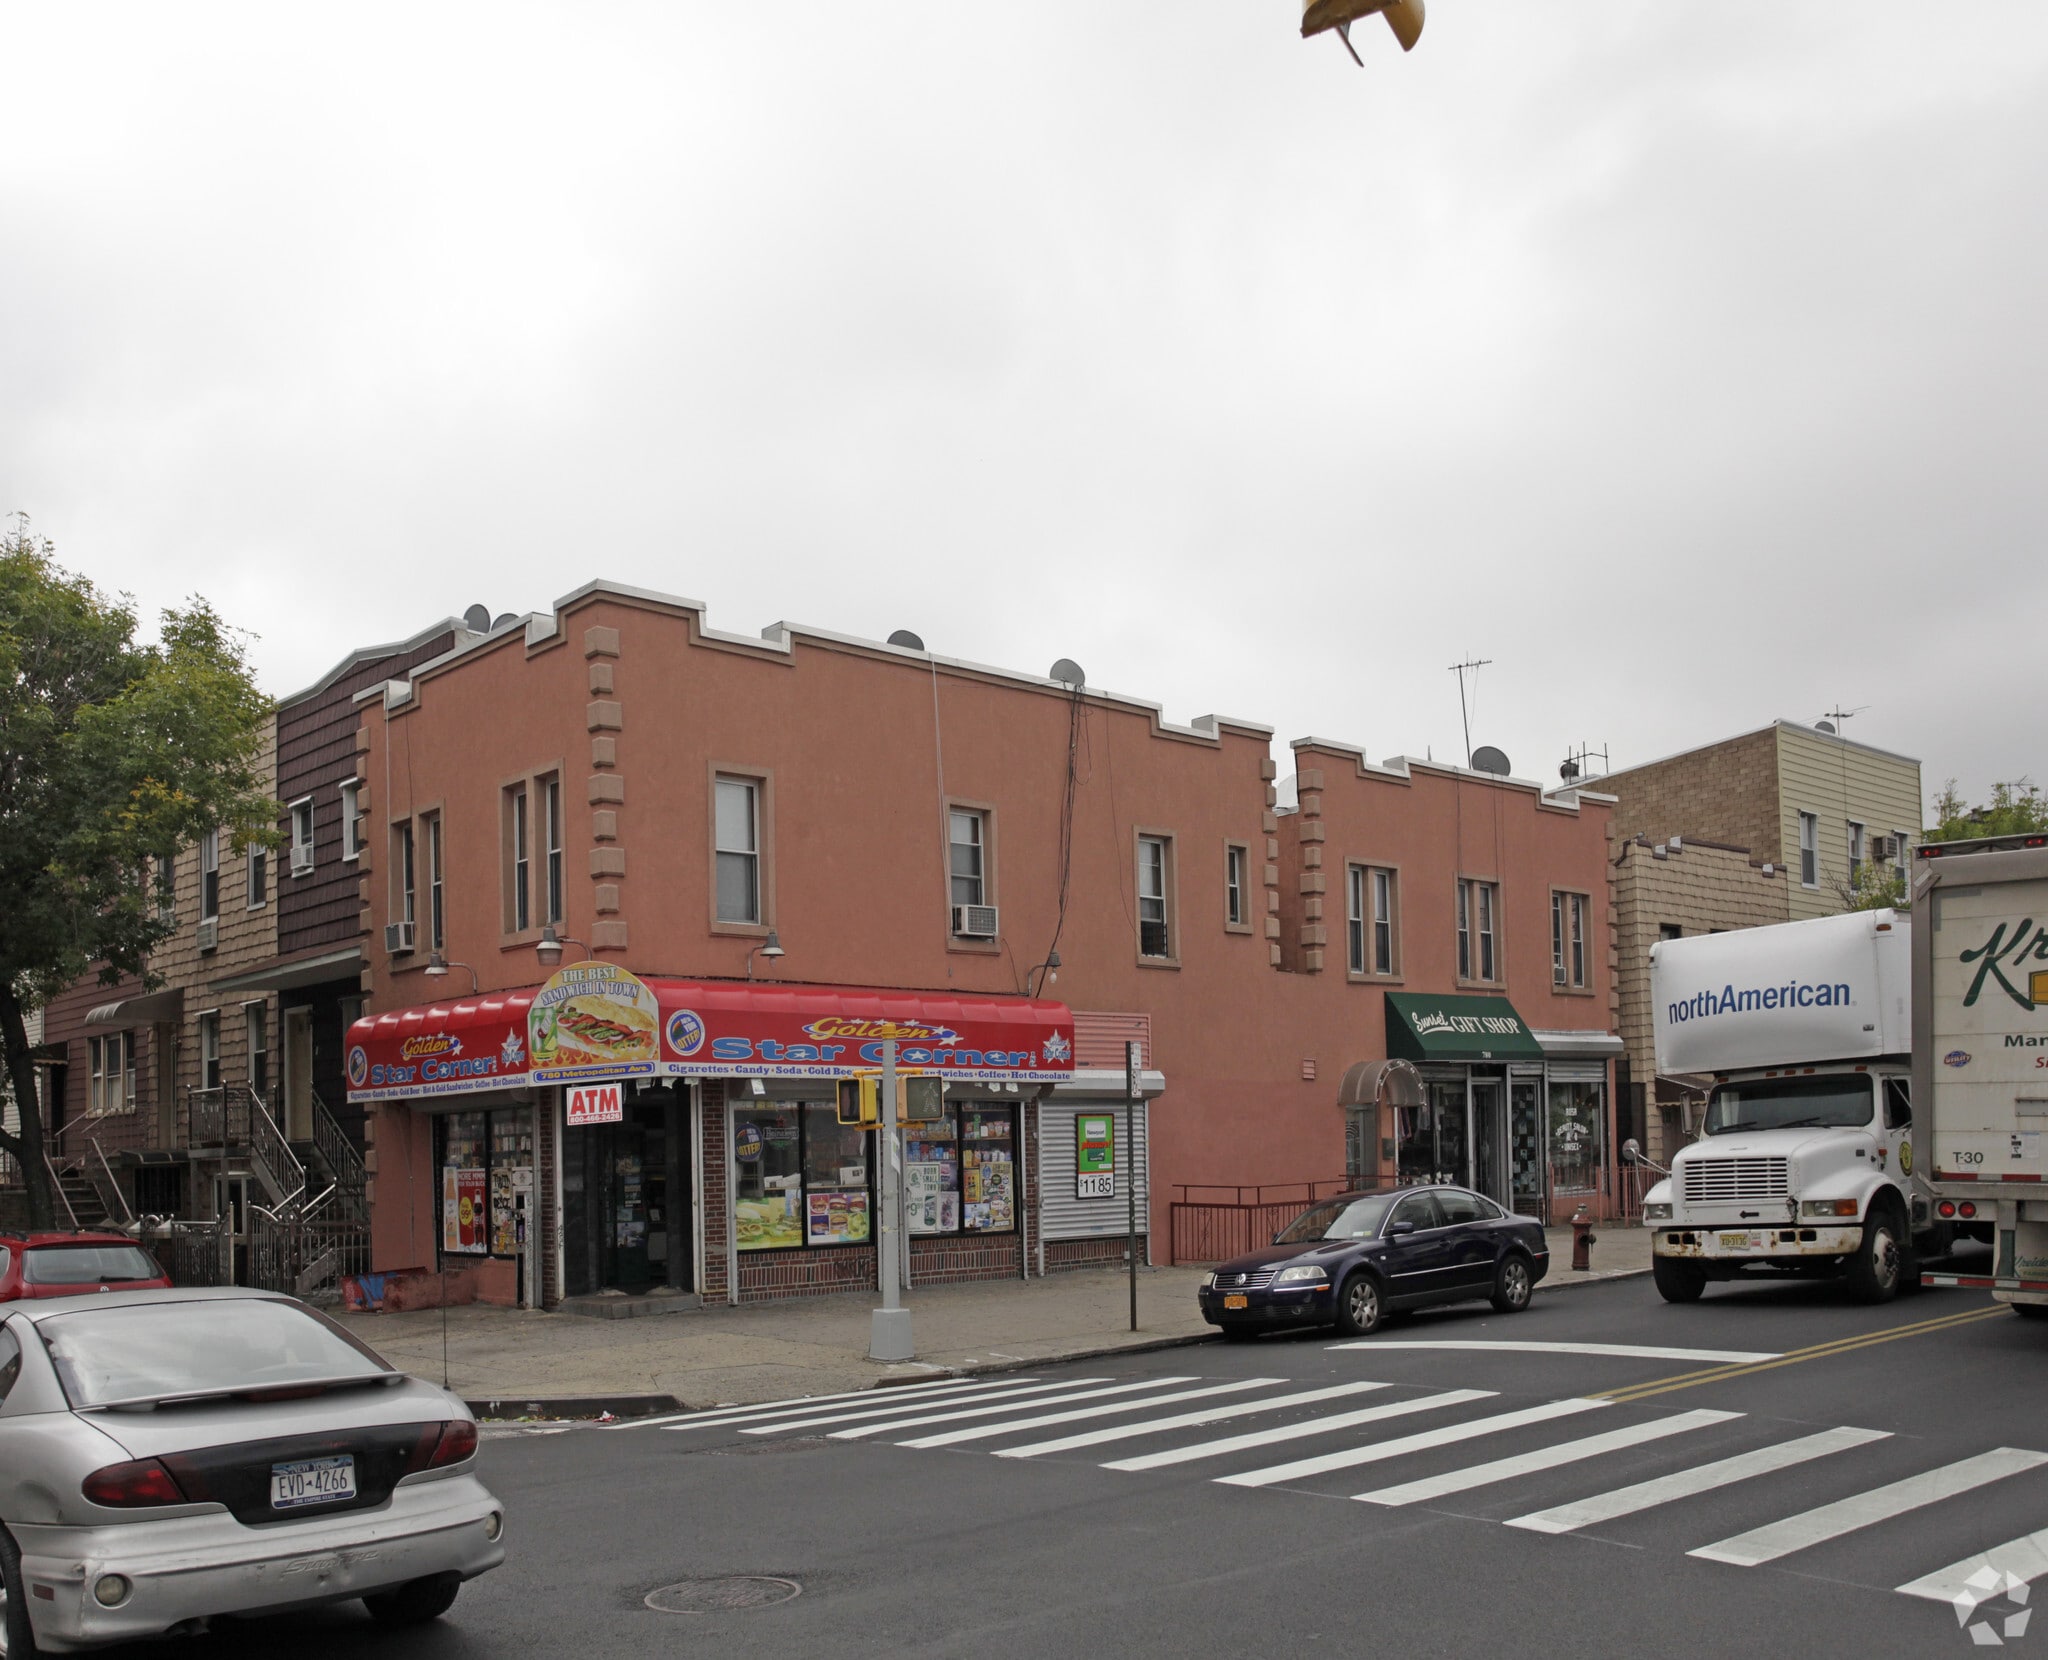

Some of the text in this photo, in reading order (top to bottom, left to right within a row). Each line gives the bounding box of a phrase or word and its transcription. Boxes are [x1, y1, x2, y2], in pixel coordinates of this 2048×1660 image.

[561, 966, 617, 983] THE BEST
[541, 981, 640, 1006] SANDWICH IN TOWN
[1668, 980, 1850, 1024] northAmerican
[1411, 1010, 1521, 1034] Sunset GIFT SHOP
[402, 1037, 450, 1061] Golden
[711, 1037, 846, 1061] Star
[859, 1042, 1028, 1067] Corner
[371, 1064, 417, 1085] Star
[421, 1056, 492, 1080] Corner
[562, 1066, 626, 1078] Metropolitan
[628, 1064, 648, 1073] Ave.
[668, 1064, 730, 1075] Cigarettes
[735, 1065, 770, 1076] Candy
[776, 1066, 803, 1075] Soda
[808, 1066, 831, 1076] Cold
[833, 1067, 854, 1076] Bee
[923, 1070, 974, 1079] andwiches
[978, 1070, 1007, 1079] Coffee
[1011, 1071, 1028, 1079] Hot
[1029, 1071, 1071, 1080] Chocolate
[446, 1081, 474, 1092] Sandwiches
[475, 1080, 490, 1089] Coffee
[502, 1077, 526, 1087] Chocolate
[570, 1088, 619, 1115] ATM
[1953, 1151, 1984, 1164] T-30
